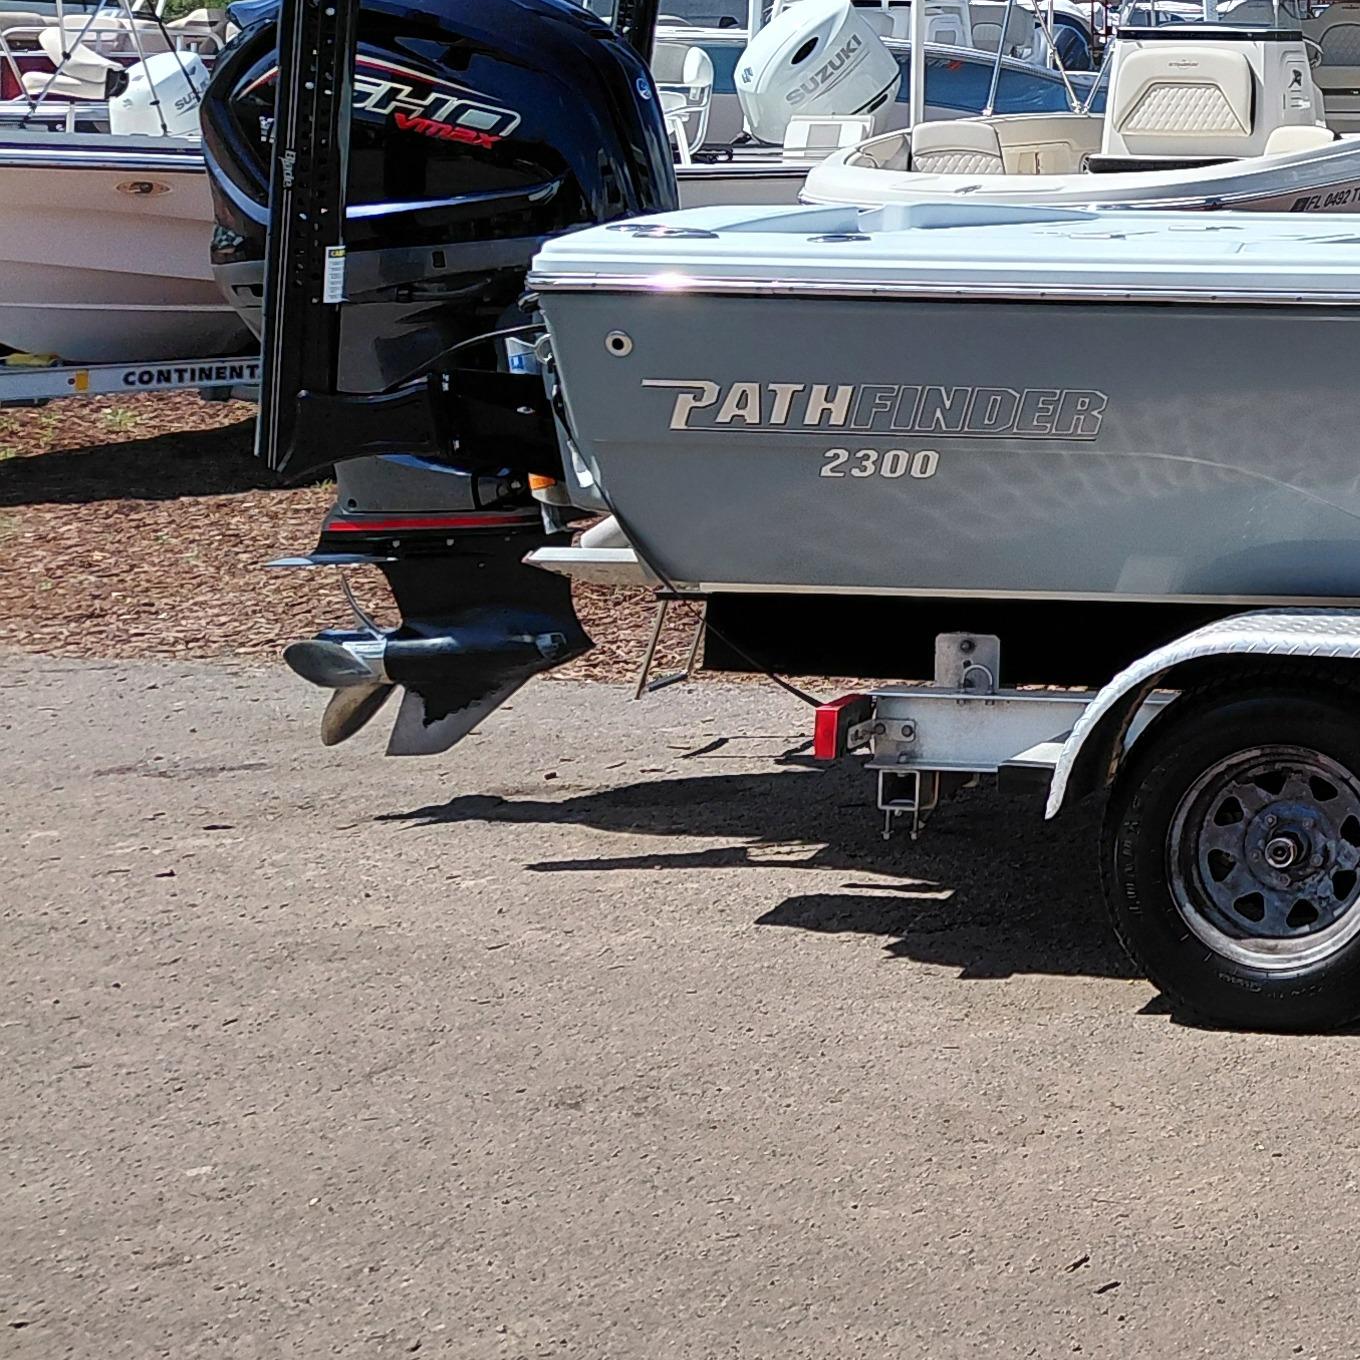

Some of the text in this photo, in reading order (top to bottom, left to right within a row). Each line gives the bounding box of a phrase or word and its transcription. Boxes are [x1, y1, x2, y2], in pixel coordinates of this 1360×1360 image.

[786, 34, 863, 107] SUZUKI
[279, 149, 297, 188] Blade
[641, 378, 1109, 439] PATHFINDER
[820, 449, 939, 479] 2300
